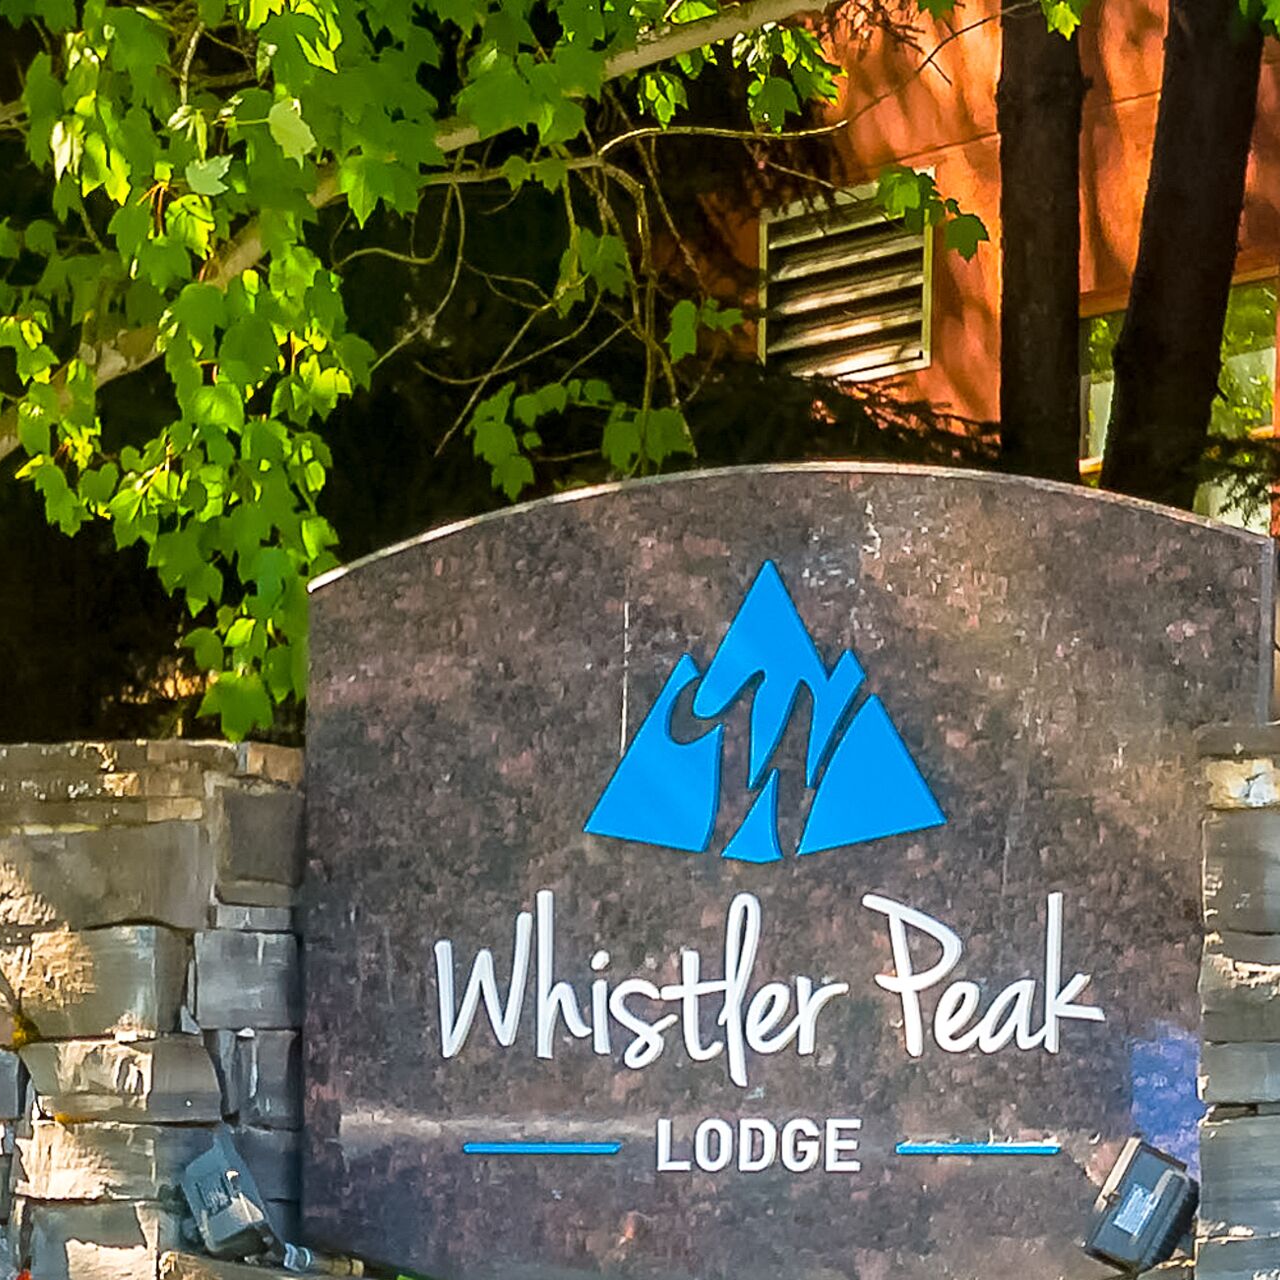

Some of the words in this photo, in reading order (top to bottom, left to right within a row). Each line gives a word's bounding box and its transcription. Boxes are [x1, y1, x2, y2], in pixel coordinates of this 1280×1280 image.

[435, 890, 849, 1087] Whistler
[862, 892, 1105, 1056] Peak
[656, 1117, 862, 1174] LODGE
